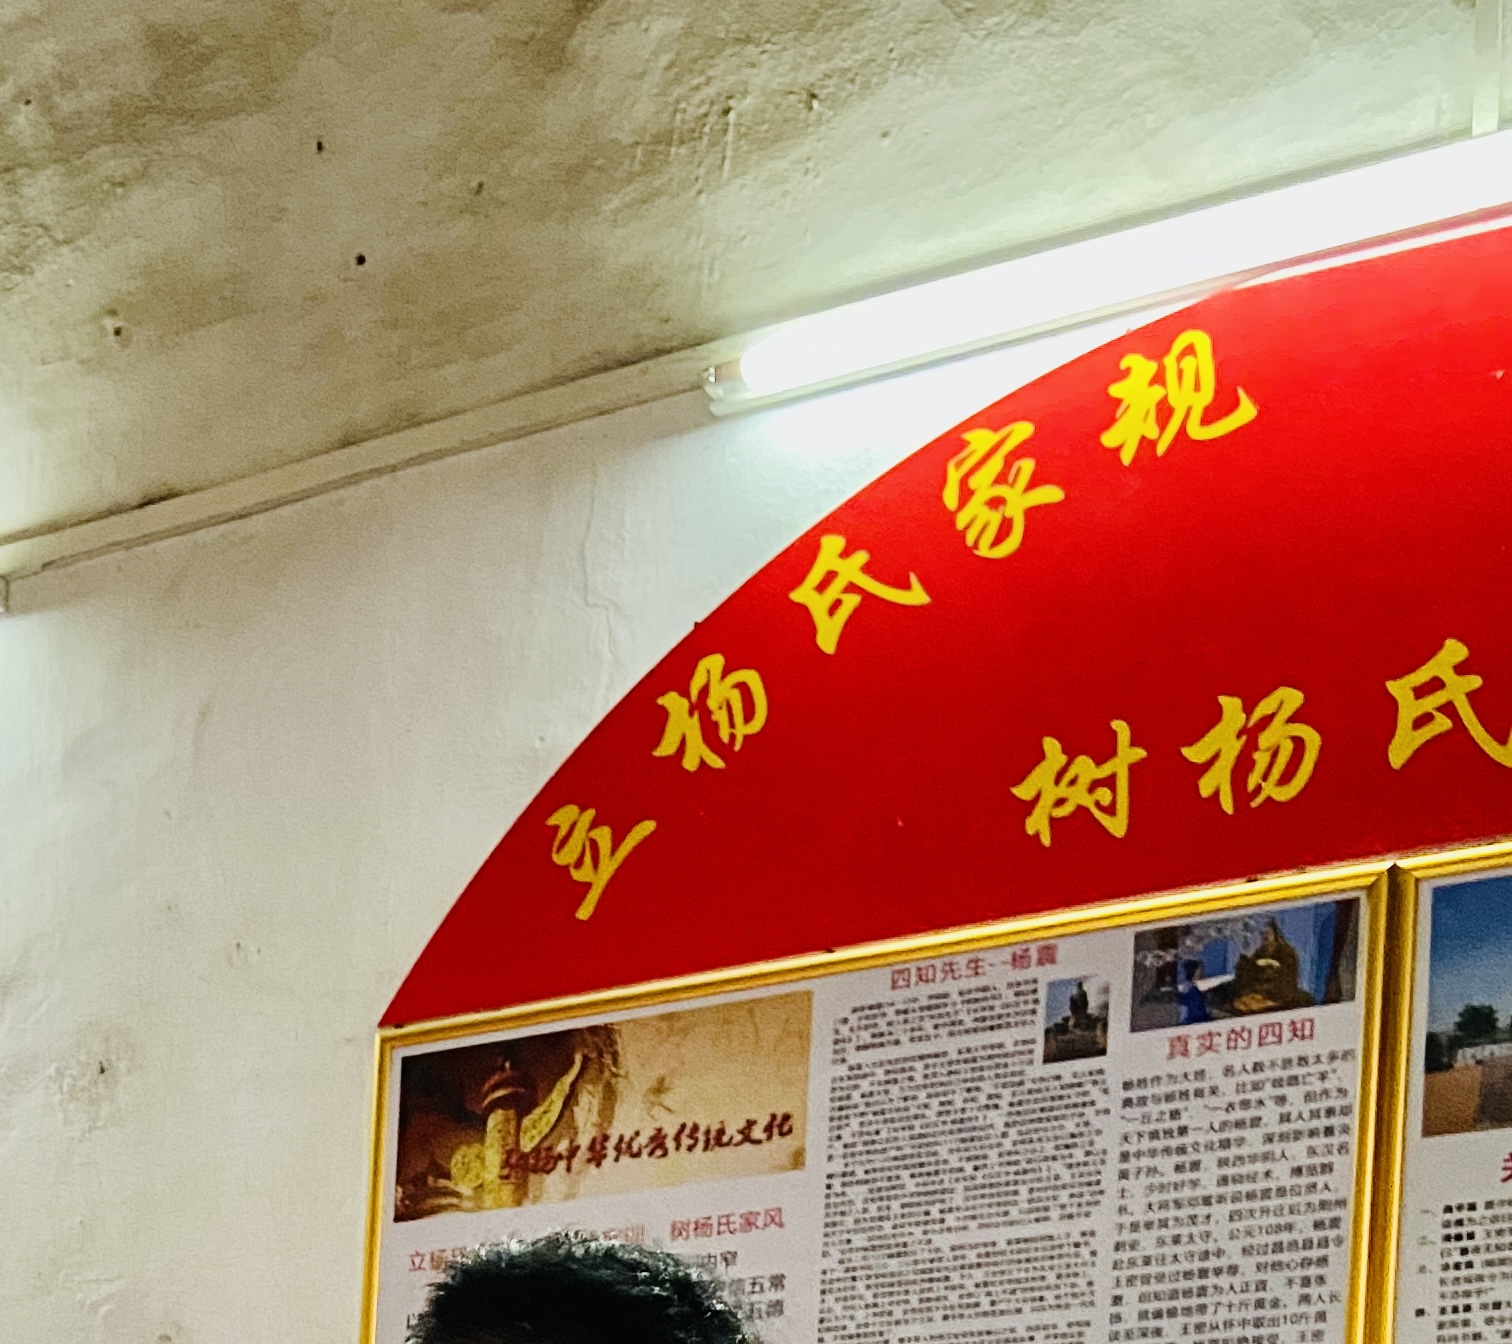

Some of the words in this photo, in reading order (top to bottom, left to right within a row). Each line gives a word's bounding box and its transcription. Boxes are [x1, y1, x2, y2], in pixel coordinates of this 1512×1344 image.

[1167, 1017, 1315, 1060] 真实的四知
[670, 1206, 785, 1242] 树杨氏家风
